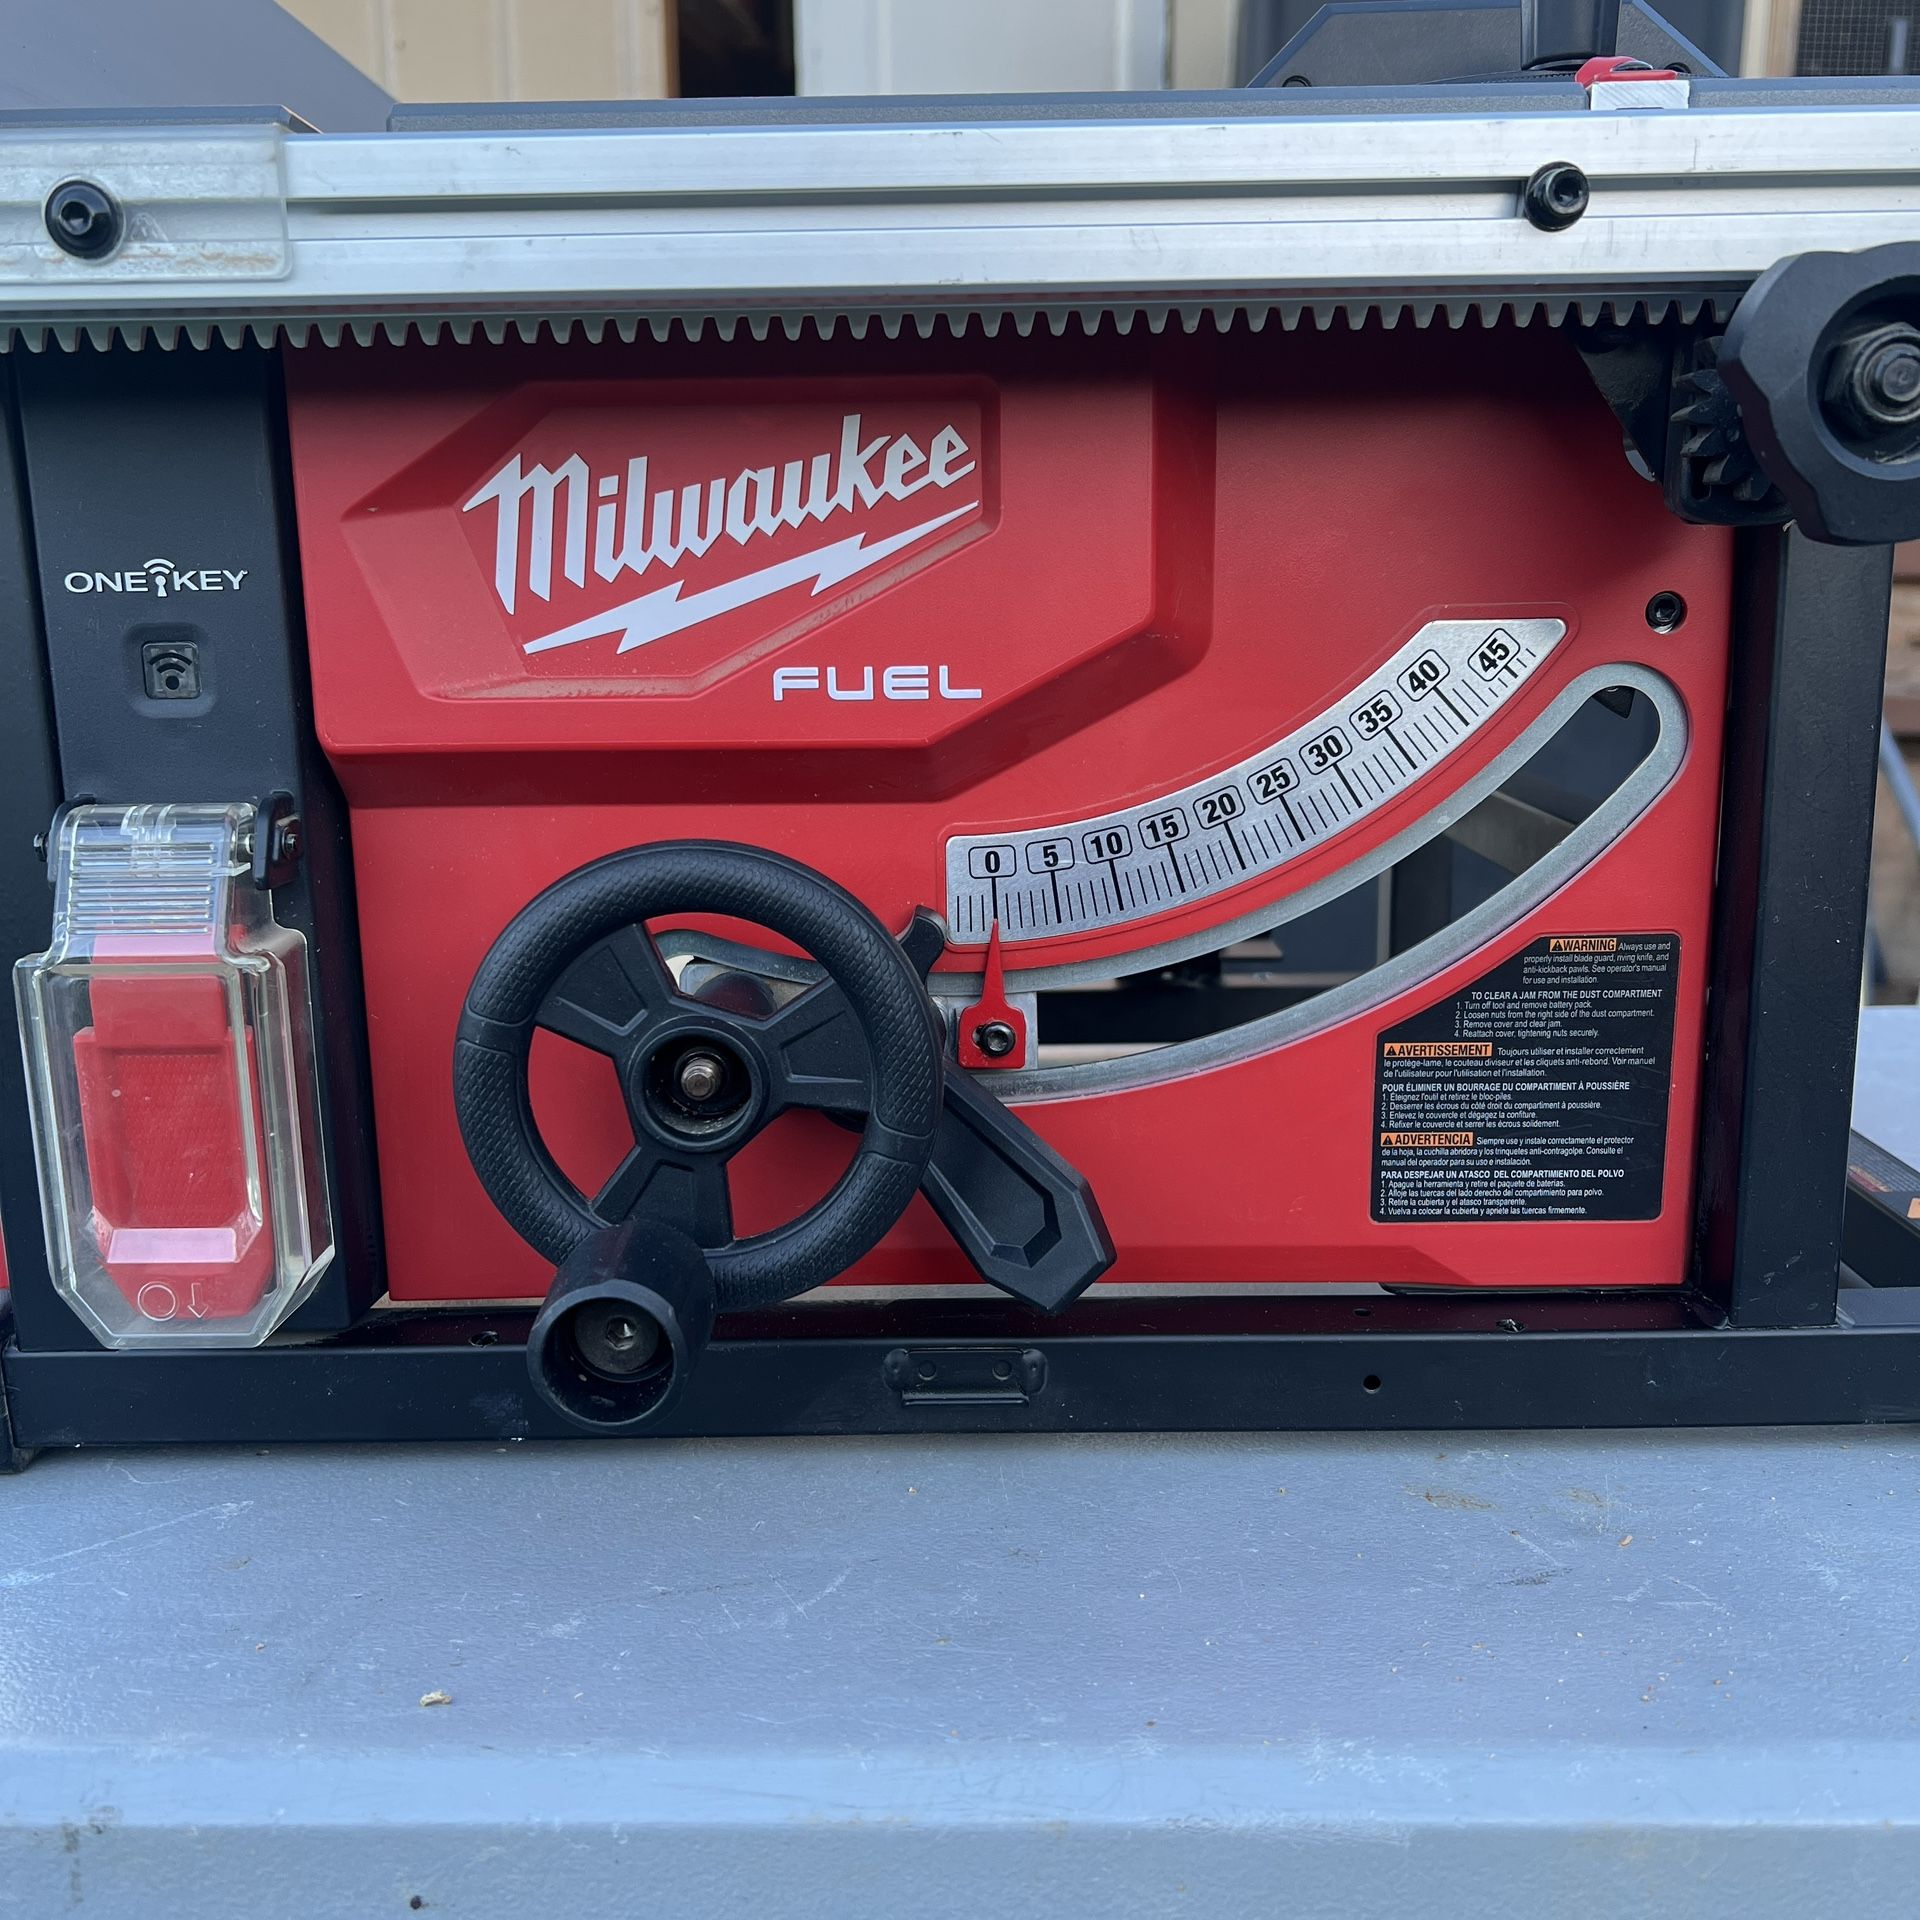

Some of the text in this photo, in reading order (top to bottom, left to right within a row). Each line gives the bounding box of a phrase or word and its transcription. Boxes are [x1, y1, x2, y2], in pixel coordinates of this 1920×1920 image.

[463, 414, 976, 615] Milwaukee
[773, 665, 982, 700] FUEL
[986, 638, 1511, 874] 0 5 10 15 20 25 30 35 40 45
[1563, 938, 1615, 951] WARNING
[1618, 942, 1642, 952] Always
[1657, 941, 1670, 949] and
[1523, 955, 1552, 965] properly
[1552, 954, 1573, 962] install
[1573, 954, 1592, 962] blade
[1616, 953, 1635, 963] riving
[1655, 953, 1669, 961] and
[1591, 964, 1605, 972] See
[1606, 964, 1640, 974] operator's
[1641, 963, 1666, 971] manual
[1522, 976, 1531, 984] for
[1546, 976, 1559, 984] and
[1471, 990, 1661, 999] TO CLEAR A JAM FROM THE DUST COMPARTMENT
[1465, 1001, 1480, 1009] Turn
[1481, 1001, 1491, 1009] off
[1492, 1001, 1505, 1009] tool
[1506, 1001, 1519, 1009] and
[1548, 1000, 1573, 1010] battery
[1463, 1011, 1489, 1019] Loosen
[1490, 1011, 1505, 1019] nuts
[1507, 1010, 1523, 1018] from
[1524, 1010, 1535, 1018] the
[1537, 1010, 1552, 1020] right
[1554, 1010, 1568, 1018] side
[1570, 1010, 1577, 1018] of
[1578, 1010, 1590, 1018] the
[1463, 1020, 1491, 1028] Remove
[1514, 1020, 1527, 1028] and
[1529, 1020, 1546, 1028] clear
[1462, 1029, 1493, 1037] Reattach
[1517, 1029, 1551, 1038] tightening
[1552, 1029, 1567, 1037] nuts
[1398, 1044, 1490, 1056] AVERTISSEMENT
[1497, 1047, 1528, 1057] Toujours
[1530, 1047, 1554, 1055] utiliser
[1555, 1047, 1563, 1055] et
[1564, 1046, 1593, 1055] installer
[1383, 1059, 1390, 1067] le
[1445, 1058, 1451, 1066] le
[1453, 1058, 1483, 1066] couteau
[1484, 1058, 1513, 1066] diviseur
[1514, 1058, 1522, 1066] et
[1523, 1058, 1534, 1066] les
[1535, 1057, 1564, 1067] cliquets
[1611, 1057, 1626, 1065] Voir
[1627, 1056, 1655, 1065] manuel
[1383, 1069, 1393, 1077] de
[1382, 1080, 1629, 1091] POUR ÉLIMINER UN BOURRAGE DU COMPARTIMENT À POUSSIÈRE
[1389, 1101, 1422, 1109] Desserrer
[1424, 1101, 1434, 1109] les
[1435, 1101, 1458, 1109] écrous
[1460, 1101, 1469, 1109] du
[1470, 1101, 1485, 1109] côté
[1486, 1101, 1502, 1109] droit
[1503, 1101, 1512, 1109] du
[1561, 1101, 1566, 1109] à
[1389, 1111, 1416, 1119] Enlevez
[1417, 1111, 1424, 1119] le
[1425, 1111, 1458, 1119] couvercle
[1459, 1111, 1466, 1119] et
[1467, 1111, 1497, 1120] dégagez
[1395, 1133, 1471, 1146] ADVERTENCIA
[1476, 1136, 1504, 1146] Siempre
[1524, 1136, 1546, 1144] instale
[1596, 1136, 1602, 1144] el
[1603, 1136, 1633, 1145] protector
[1381, 1170, 1402, 1178] PARA
[1403, 1170, 1444, 1178] DESPEJAR
[1445, 1170, 1456, 1178] UN
[1458, 1170, 1490, 1178] ATASCO
[1493, 1170, 1508, 1178] DEL
[1510, 1170, 1579, 1178] COMPARTIMIENTO
[1418, 1206, 1442, 1214] colocar
[1443, 1206, 1450, 1214] la
[1451, 1206, 1478, 1214] cubierta
[1485, 1206, 1508, 1216] apriete
[1510, 1206, 1520, 1214] las
[1521, 1206, 1546, 1214] tuercas
